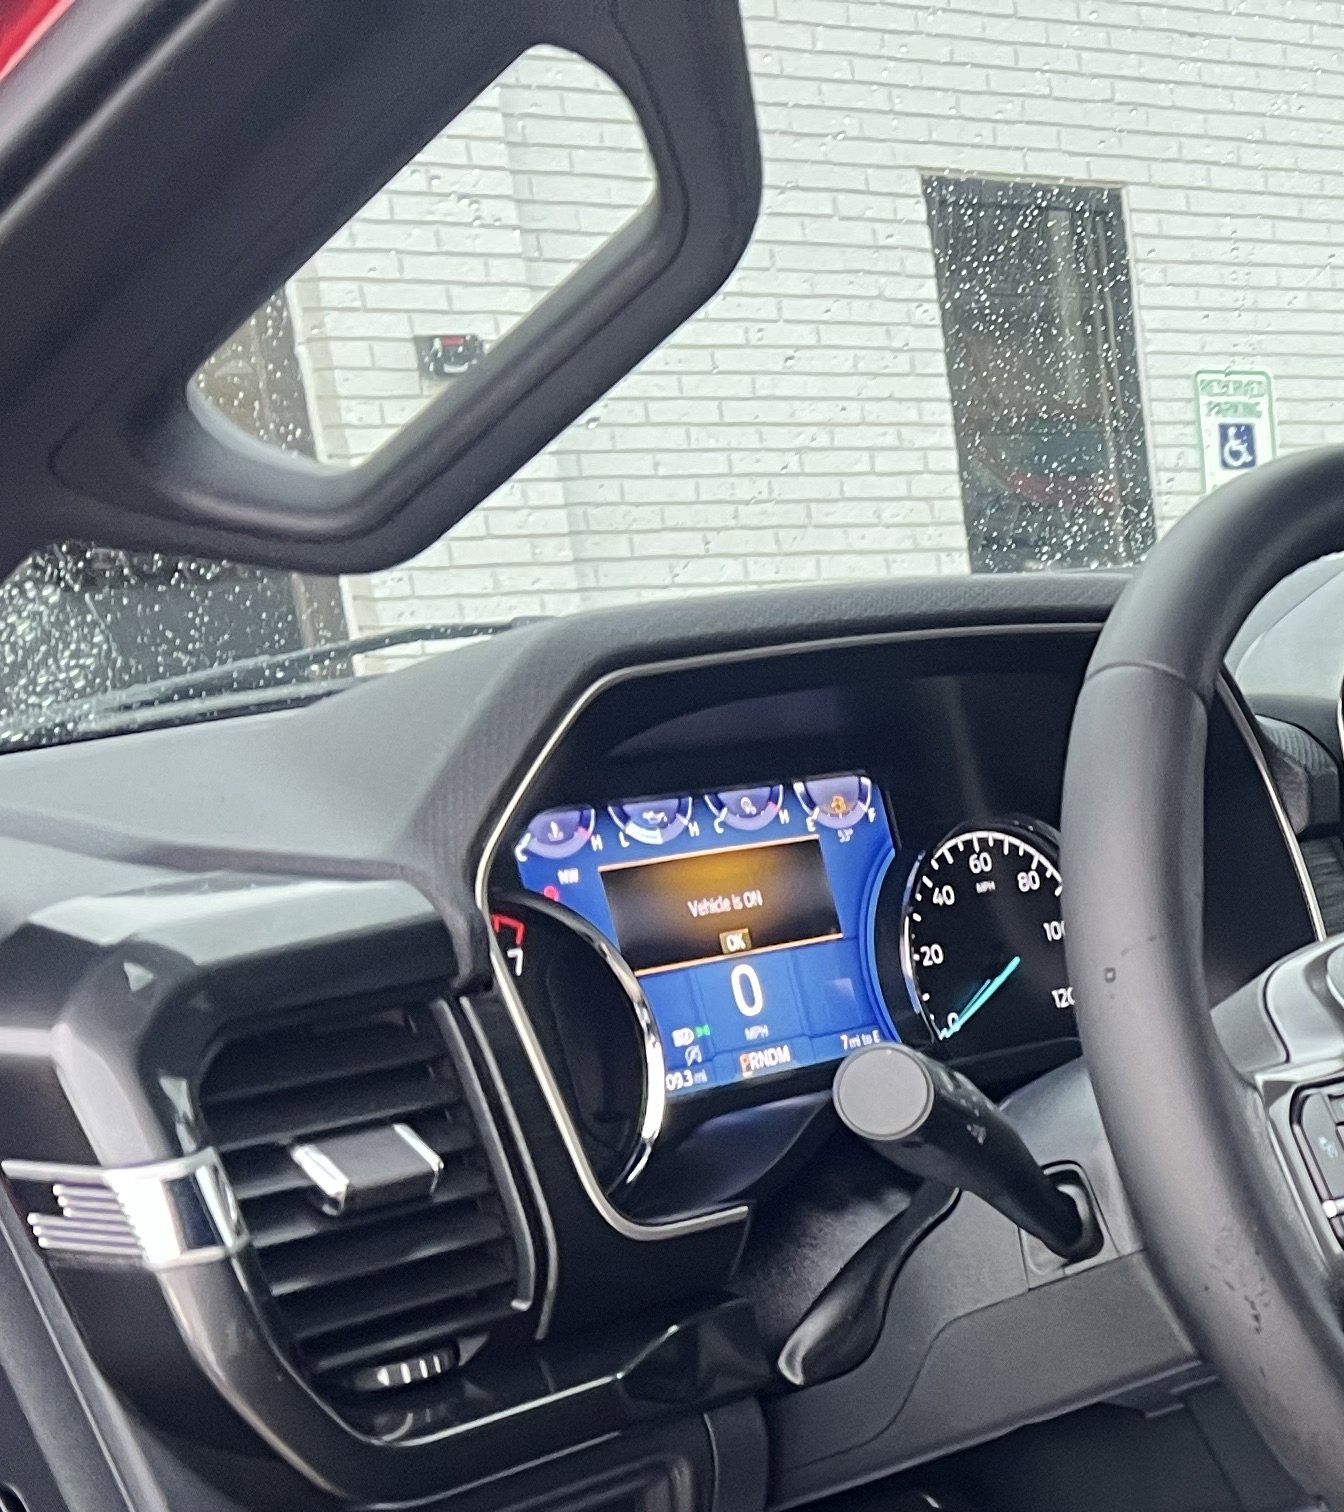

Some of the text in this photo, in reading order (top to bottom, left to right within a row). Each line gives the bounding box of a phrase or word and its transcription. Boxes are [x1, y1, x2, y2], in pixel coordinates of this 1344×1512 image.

[968, 852, 992, 874] 60
[1016, 870, 1041, 892] 80
[687, 889, 763, 917] Vehicle is ON
[932, 885, 956, 906] 40
[726, 932, 746, 952] OK
[507, 947, 524, 977] 7
[920, 943, 944, 967] 20
[730, 964, 764, 1017] 0
